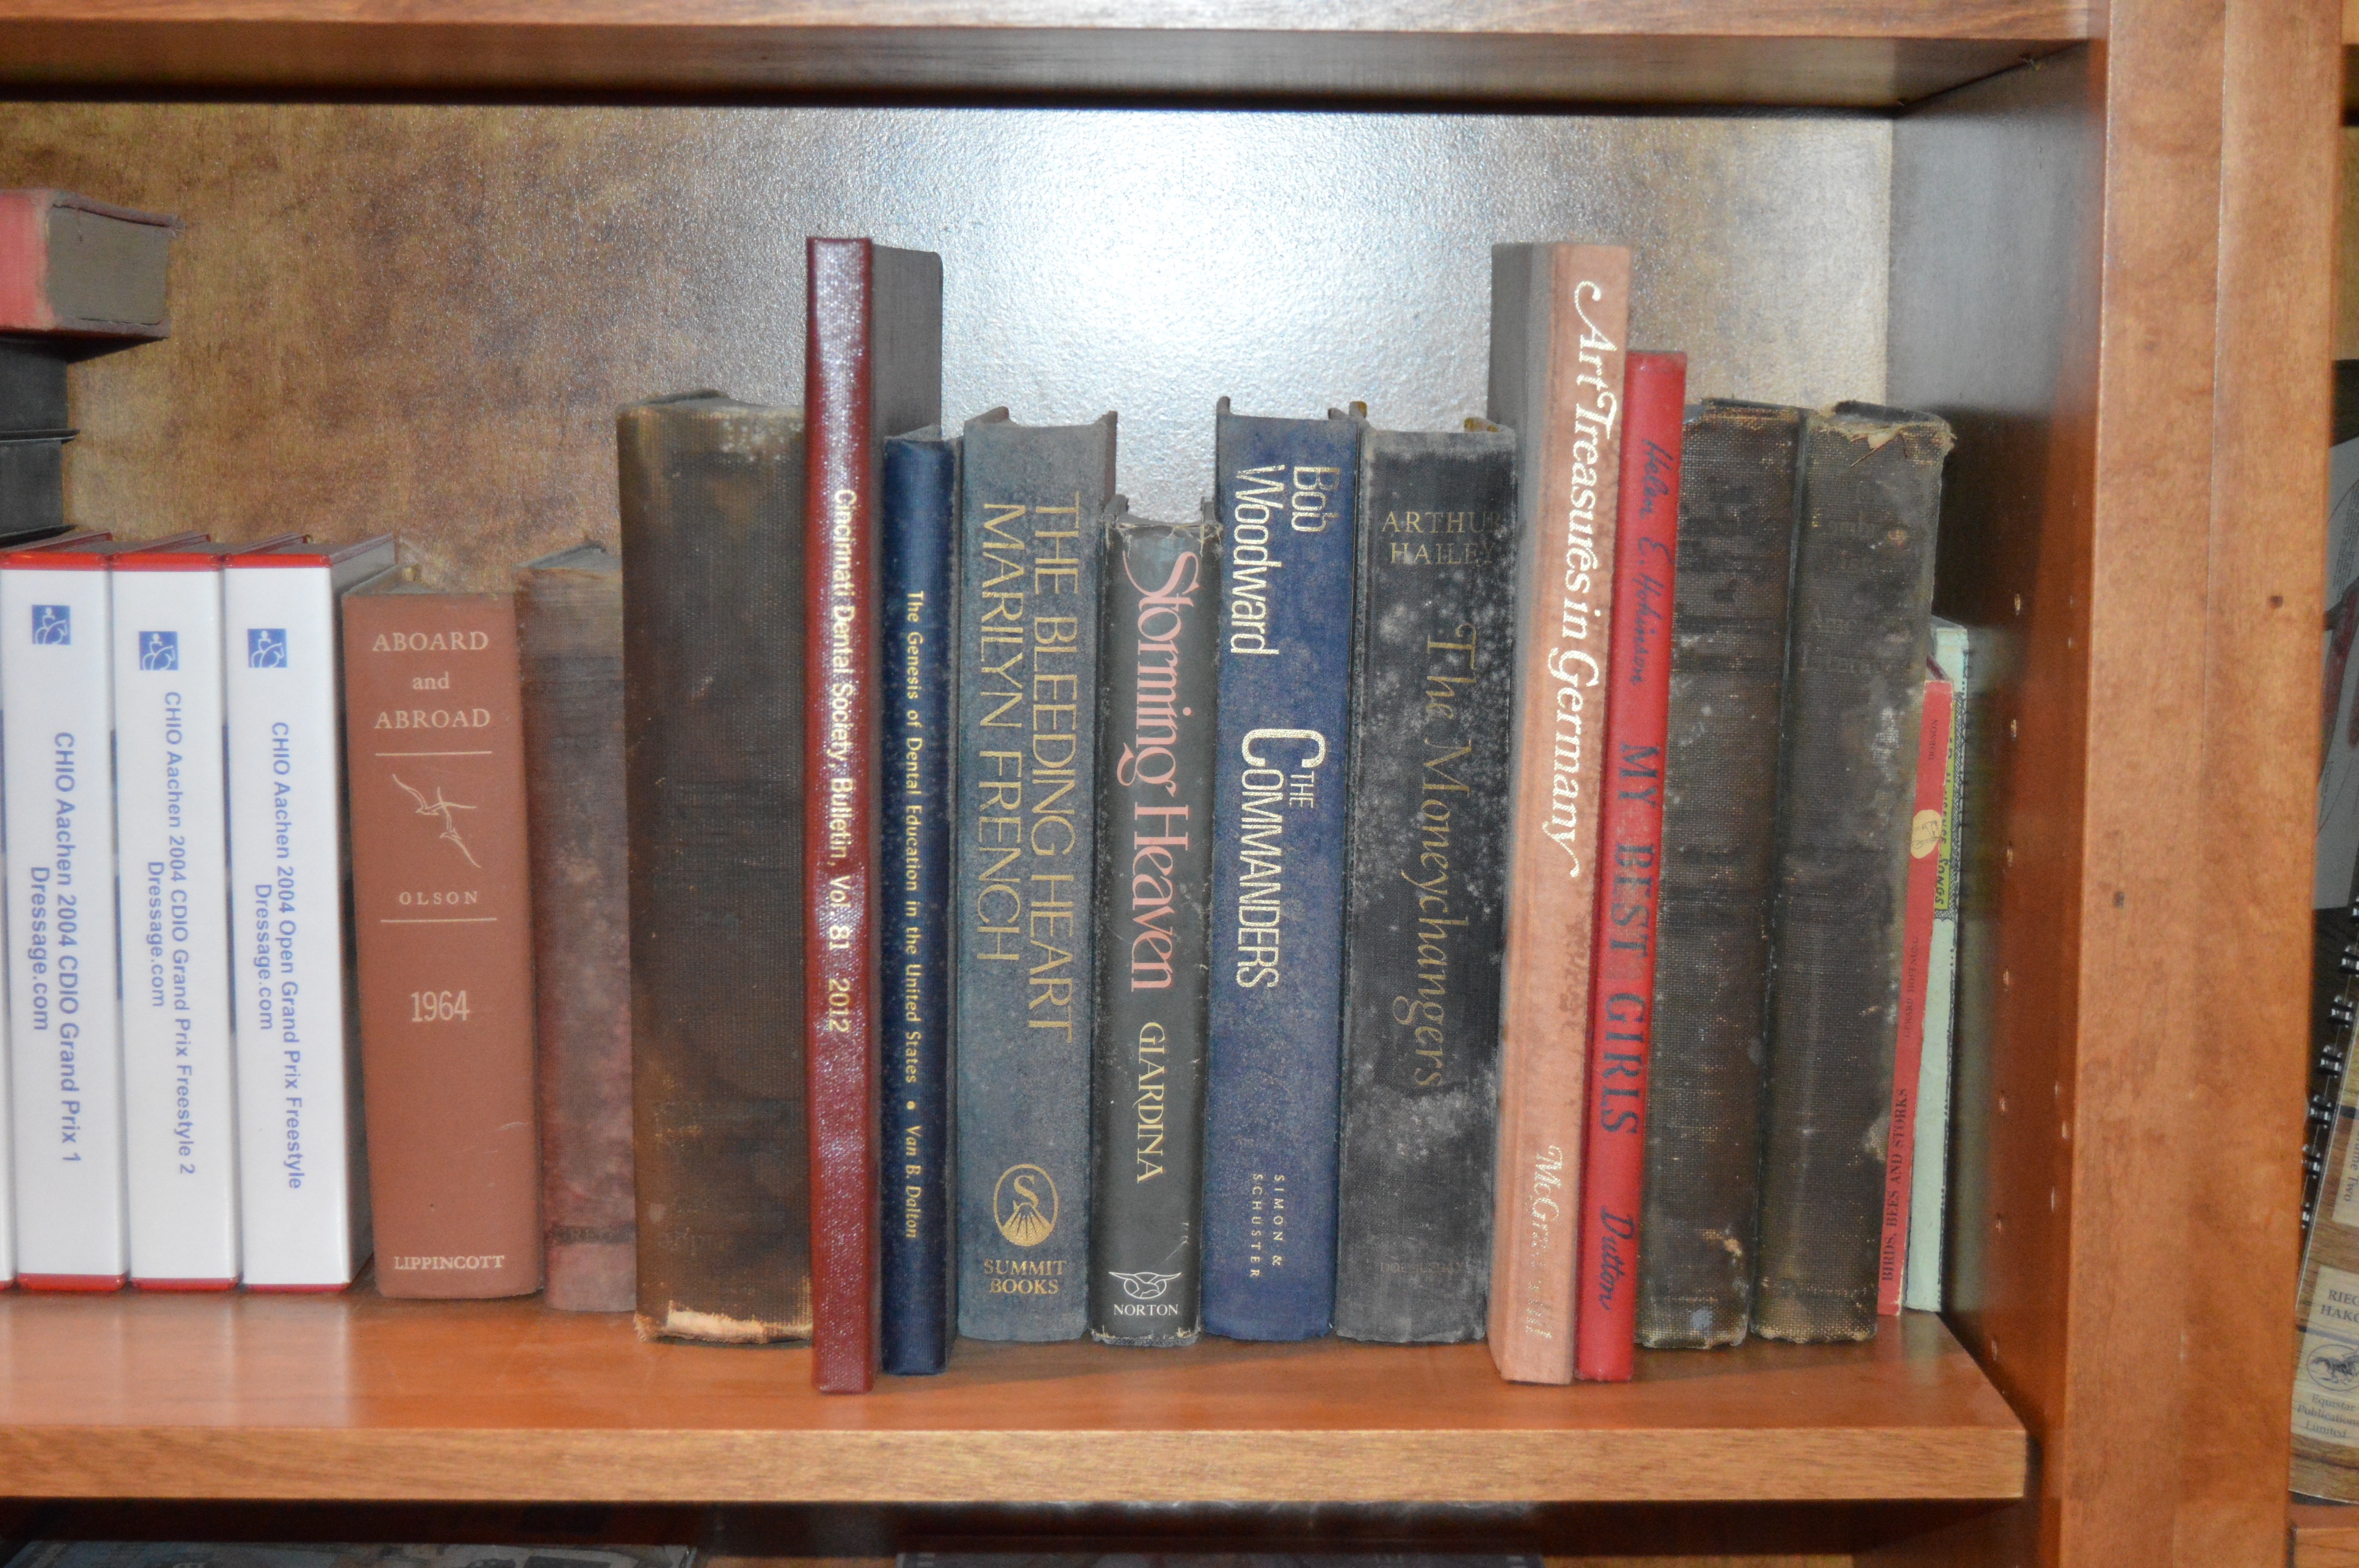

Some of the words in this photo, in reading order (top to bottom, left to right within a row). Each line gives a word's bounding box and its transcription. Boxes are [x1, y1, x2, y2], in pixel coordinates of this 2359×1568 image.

[1574, 281, 1617, 390] Art
[1291, 466, 1340, 532] Bob
[1565, 392, 1617, 593] Treasures
[833, 489, 856, 596] Cincinnati
[1035, 491, 1079, 594] THE
[1381, 511, 1504, 533] ARTHUR
[1231, 465, 1285, 654] Woodward
[1390, 542, 1494, 564] HAILEY
[907, 591, 924, 622] The
[980, 504, 1026, 728] MARILYN
[1563, 598, 1600, 639] in
[373, 631, 489, 651] ABOARD
[833, 607, 855, 673] Dental
[908, 632, 923, 700] Genesis
[413, 672, 450, 689] and
[1117, 550, 1200, 797] Storming
[1426, 623, 1476, 720] The
[165, 691, 182, 744] CHIO
[374, 708, 490, 729] ABROAD
[827, 685, 855, 768] Society,
[907, 711, 922, 728] of
[1031, 617, 1078, 856] BLEEDING
[1928, 719, 1938, 760] DOBSON
[54, 732, 75, 792] CHIO
[272, 722, 291, 776] CHIO
[906, 737, 922, 794] Dental
[1542, 647, 1599, 877] Germany
[1617, 742, 1660, 808] MY
[167, 751, 184, 827] Aachen
[1289, 771, 1315, 808] THE
[56, 799, 76, 885] Aachen
[274, 781, 293, 859] Aachen
[828, 779, 853, 866] Bulletin,
[906, 805, 923, 891] Education
[169, 836, 186, 881] 2004
[977, 751, 1022, 960] FRENCH
[1236, 729, 1325, 987] COMMANDERS
[171, 890, 188, 941] CDIO
[277, 867, 295, 912] 2004
[399, 891, 478, 905] OLSON
[906, 901, 921, 917] in
[1131, 802, 1188, 992] Heaven
[1392, 739, 1471, 1087] Moneychangers
[1610, 843, 1655, 959] BEST
[27, 867, 50, 1031] Dressage.com
[58, 894, 76, 947] 2004
[146, 862, 164, 1007] Dressage.com
[276, 922, 296, 974] Open
[829, 925, 850, 950] 81
[906, 927, 922, 955] the
[59, 955, 78, 1014] CDIO
[173, 949, 190, 1010] Grand
[254, 884, 272, 1030] Dressage.com
[1028, 874, 1074, 1043] HEART
[281, 982, 299, 1042] Grand
[411, 987, 469, 1022] 1964
[829, 979, 850, 1032] 2012
[905, 965, 922, 1022] United
[60, 1022, 79, 1091] Grand
[176, 1018, 191, 1056] Prix
[905, 1032, 922, 1083] States
[1600, 993, 1646, 1134] GIRLS
[284, 1051, 300, 1089] Prix
[61, 1100, 80, 1144] Prix
[174, 1065, 194, 1156] Freestyle
[1133, 1022, 1166, 1183] GIARDINA
[1893, 1088, 1907, 1147] STORKS
[180, 1163, 195, 1174] 2
[283, 1098, 304, 1189] Freestyle
[906, 1125, 921, 1157] Van
[1890, 1154, 1903, 1184] AND
[906, 1165, 921, 1180] B.
[906, 1185, 921, 1239] Dalton
[1250, 1174, 1263, 1277] SCHUSTER
[1273, 1174, 1285, 1241] SIMON
[1886, 1191, 1899, 1226] BEES
[394, 1255, 505, 1270] LIPPINCOTT
[984, 1259, 1066, 1276] SUMMIT
[1272, 1255, 1282, 1266] &
[1599, 1205, 1635, 1311] Dutton
[1882, 1232, 1897, 1281] BIRDS,
[989, 1278, 1059, 1295] BOOKS
[1114, 1304, 1178, 1316] NORTON
[2305, 1421, 2346, 1438] Limited
[2312, 1394, 2356, 1411] Equistar
